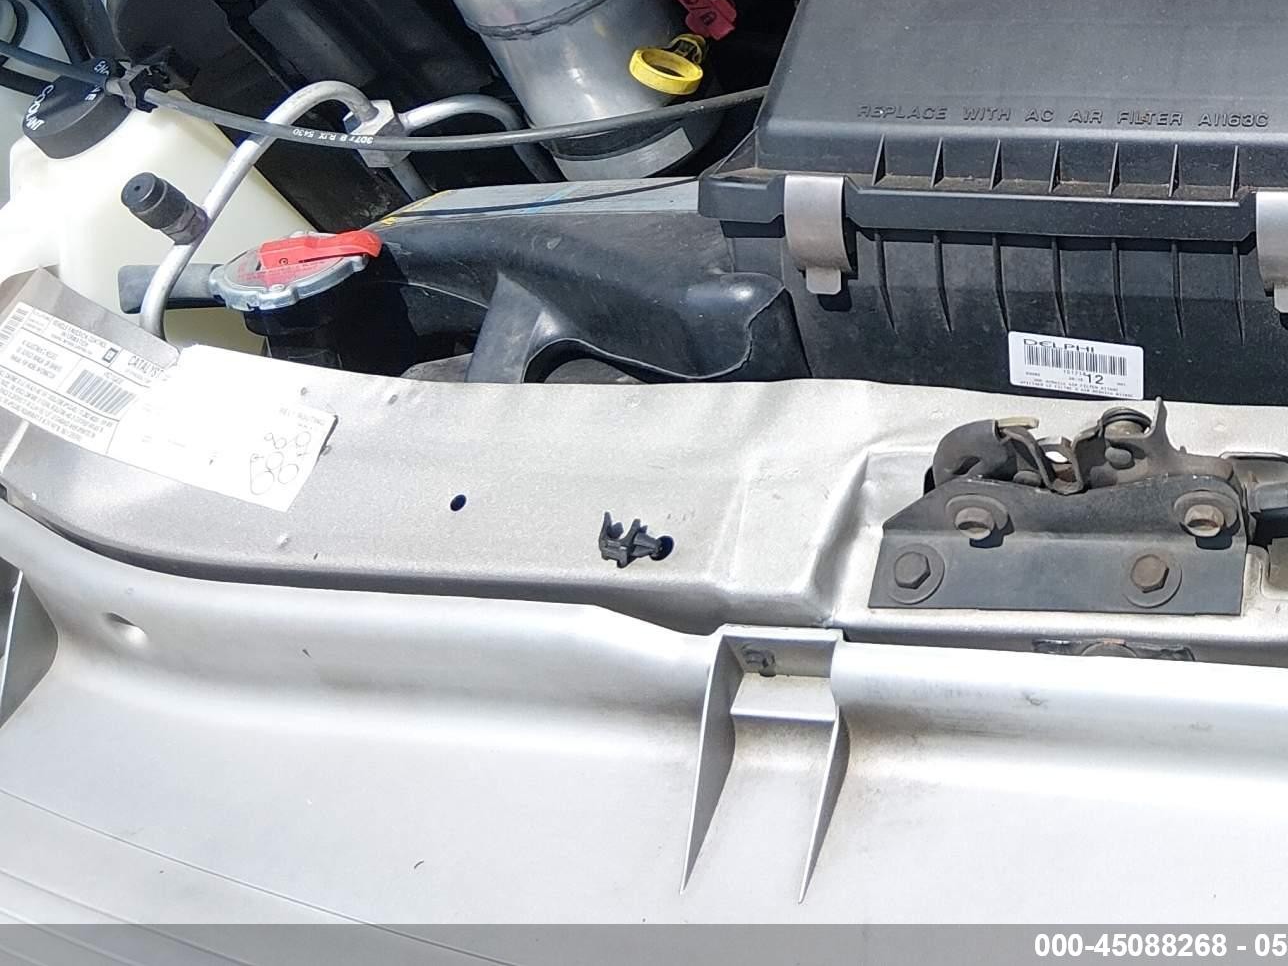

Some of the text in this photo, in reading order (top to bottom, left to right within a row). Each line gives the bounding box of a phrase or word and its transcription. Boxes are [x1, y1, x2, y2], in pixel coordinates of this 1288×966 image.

[857, 105, 947, 122] REPLACE
[962, 107, 1012, 123] WITH
[1024, 108, 1055, 124] AC
[1068, 109, 1103, 125] AIR
[1117, 111, 1183, 126] FILTER
[1023, 338, 1094, 352] DELPHI
